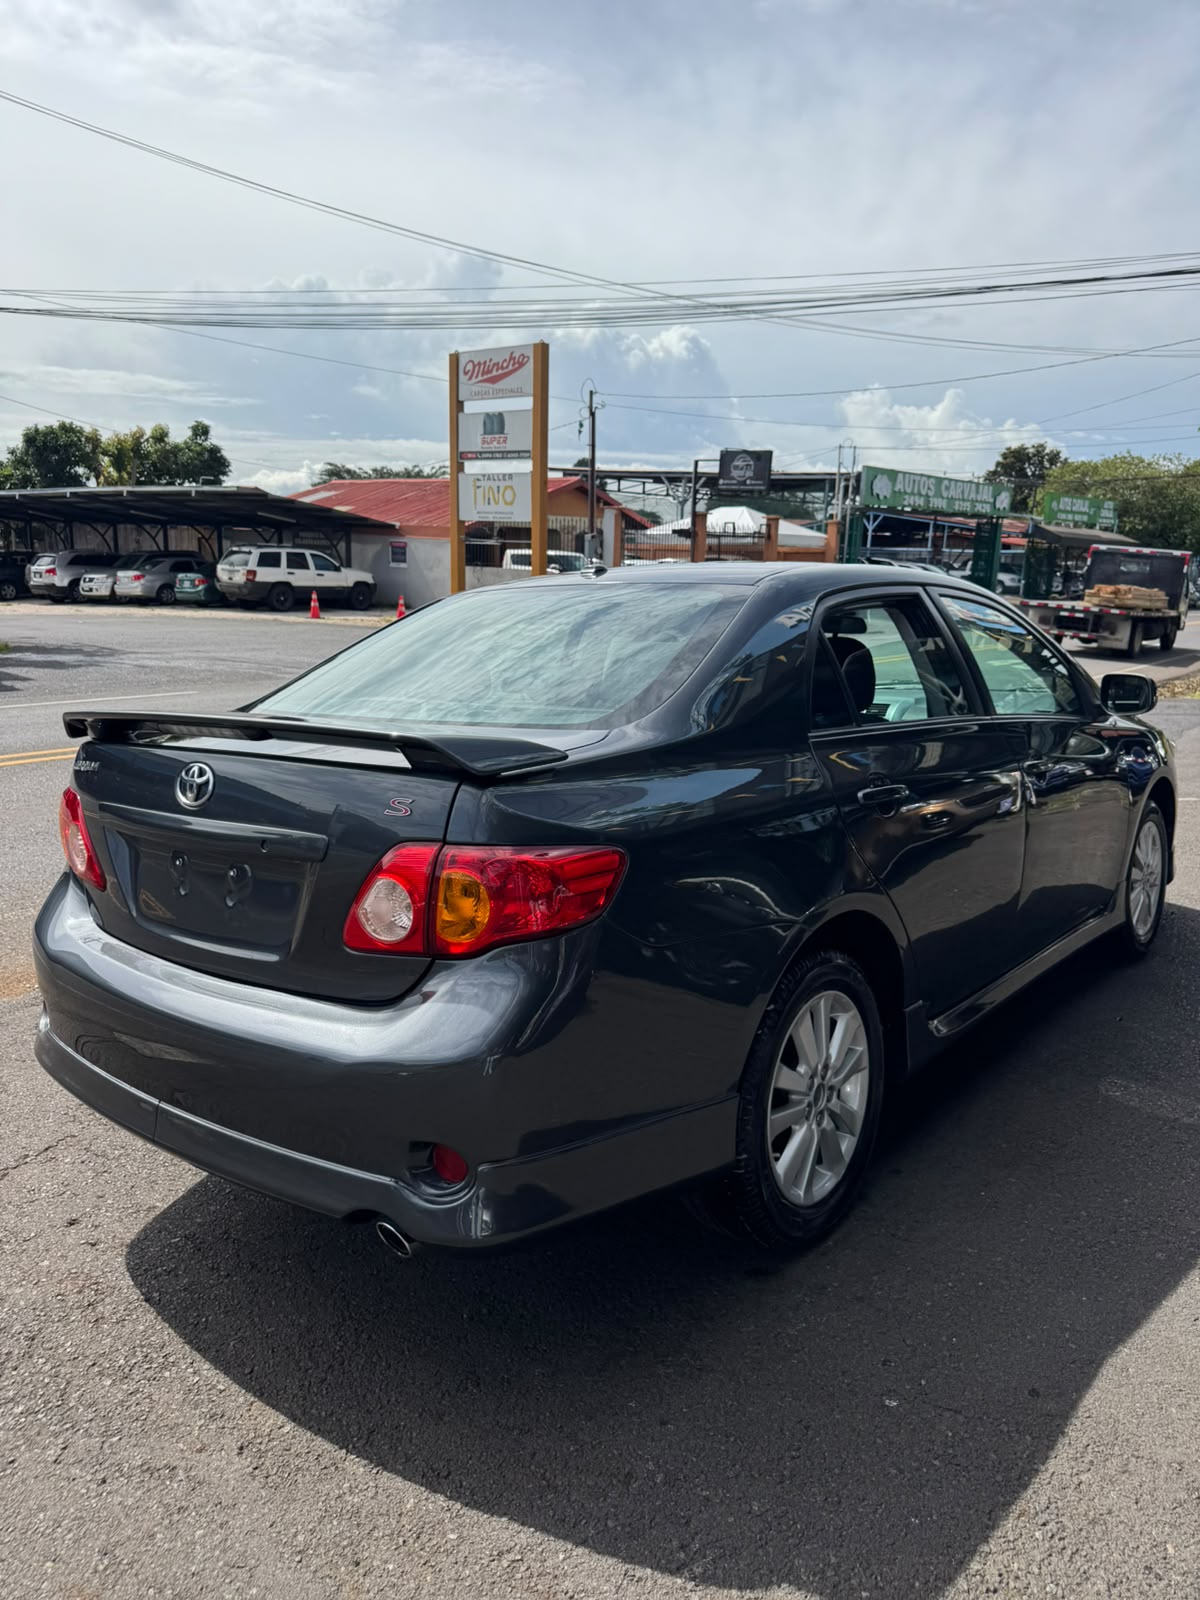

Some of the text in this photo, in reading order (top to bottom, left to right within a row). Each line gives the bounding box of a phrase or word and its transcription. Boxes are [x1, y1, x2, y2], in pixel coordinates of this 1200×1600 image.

[463, 351, 529, 381] Mincho
[481, 436, 508, 445] SUPER
[481, 474, 513, 482] TALLER
[894, 473, 993, 502] AUTOS CARVAJAL
[472, 478, 516, 510] FINO
[384, 798, 412, 816] S
